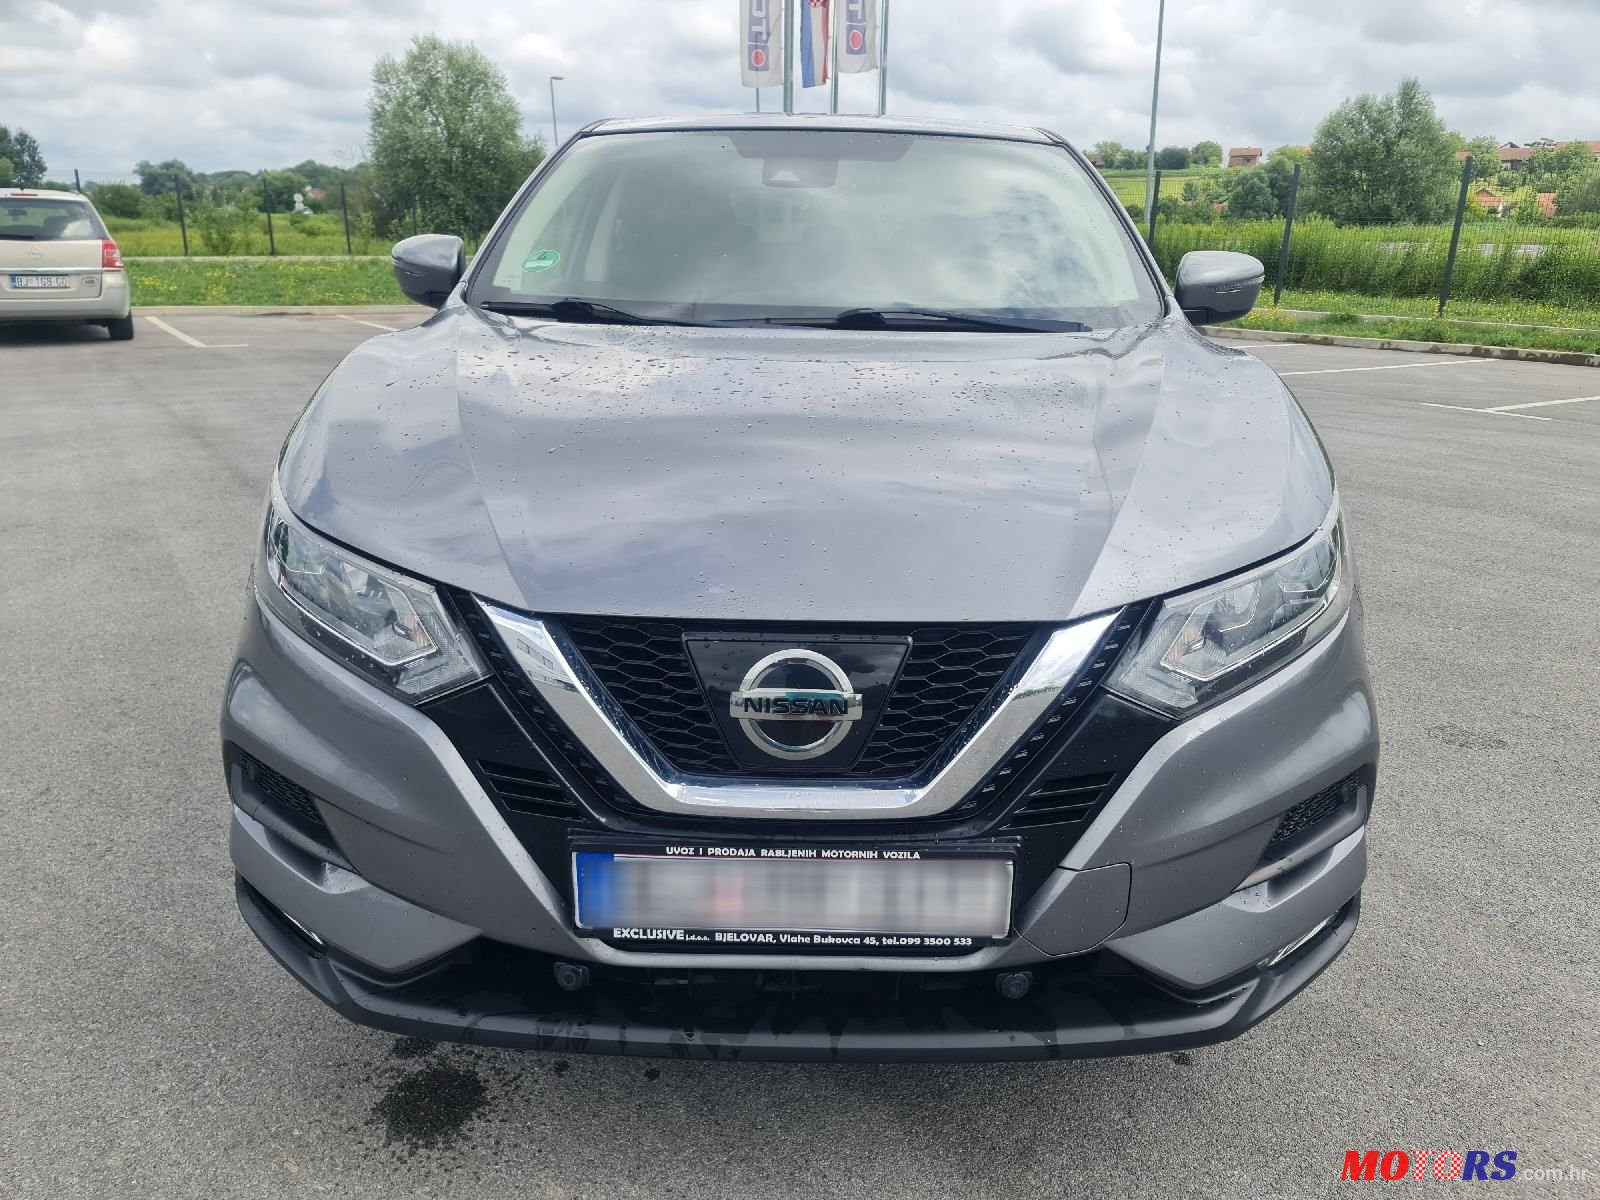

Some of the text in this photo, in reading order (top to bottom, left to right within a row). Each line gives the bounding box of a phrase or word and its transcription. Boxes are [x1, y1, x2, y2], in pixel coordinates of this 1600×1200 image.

[744, 697, 849, 716] NISSAN
[665, 846, 695, 856] UVOZ
[707, 847, 757, 858] PRODAJA
[760, 848, 817, 858] RABLJENIH
[821, 849, 878, 859] MOTORNIH
[882, 850, 921, 860] VOZILA
[613, 927, 685, 940] EXCLUSIVE
[714, 932, 777, 944] BJELOVAR,
[779, 933, 811, 944] Vlahe
[813, 935, 861, 945] Bukovca
[863, 936, 880, 946] 45,
[923, 937, 951, 946] 3500
[953, 937, 972, 946] 533
